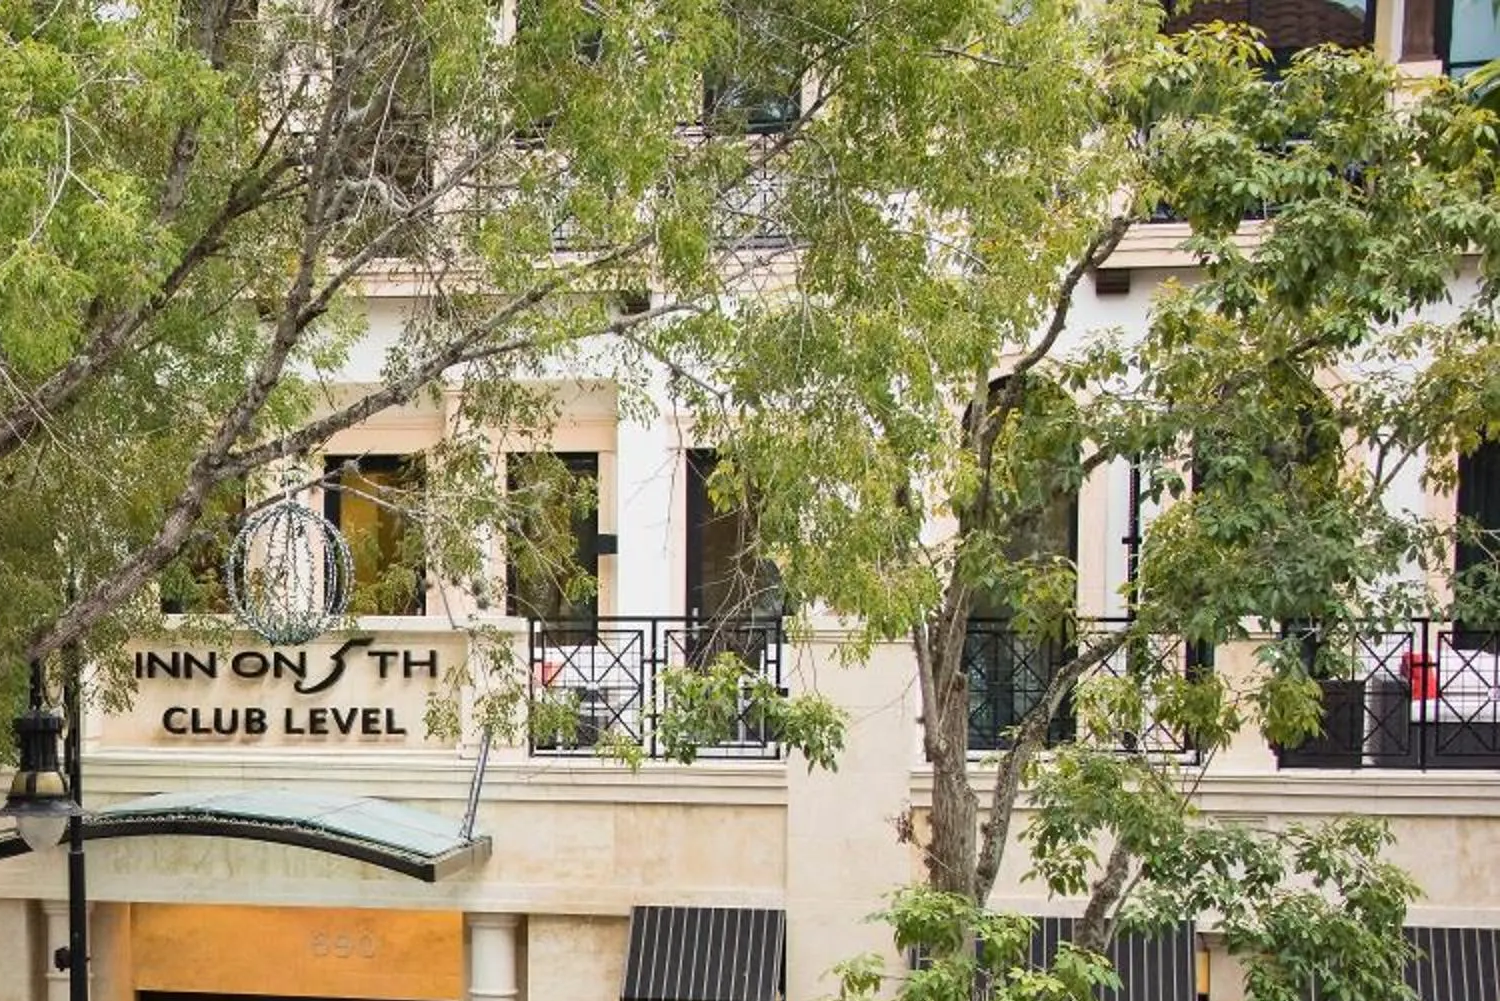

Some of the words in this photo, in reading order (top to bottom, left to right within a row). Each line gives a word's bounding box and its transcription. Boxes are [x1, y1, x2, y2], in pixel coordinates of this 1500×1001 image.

[135, 650, 217, 679] INN
[230, 650, 306, 679] ON
[161, 705, 268, 736] CLUB
[284, 707, 407, 736] LEVEL
